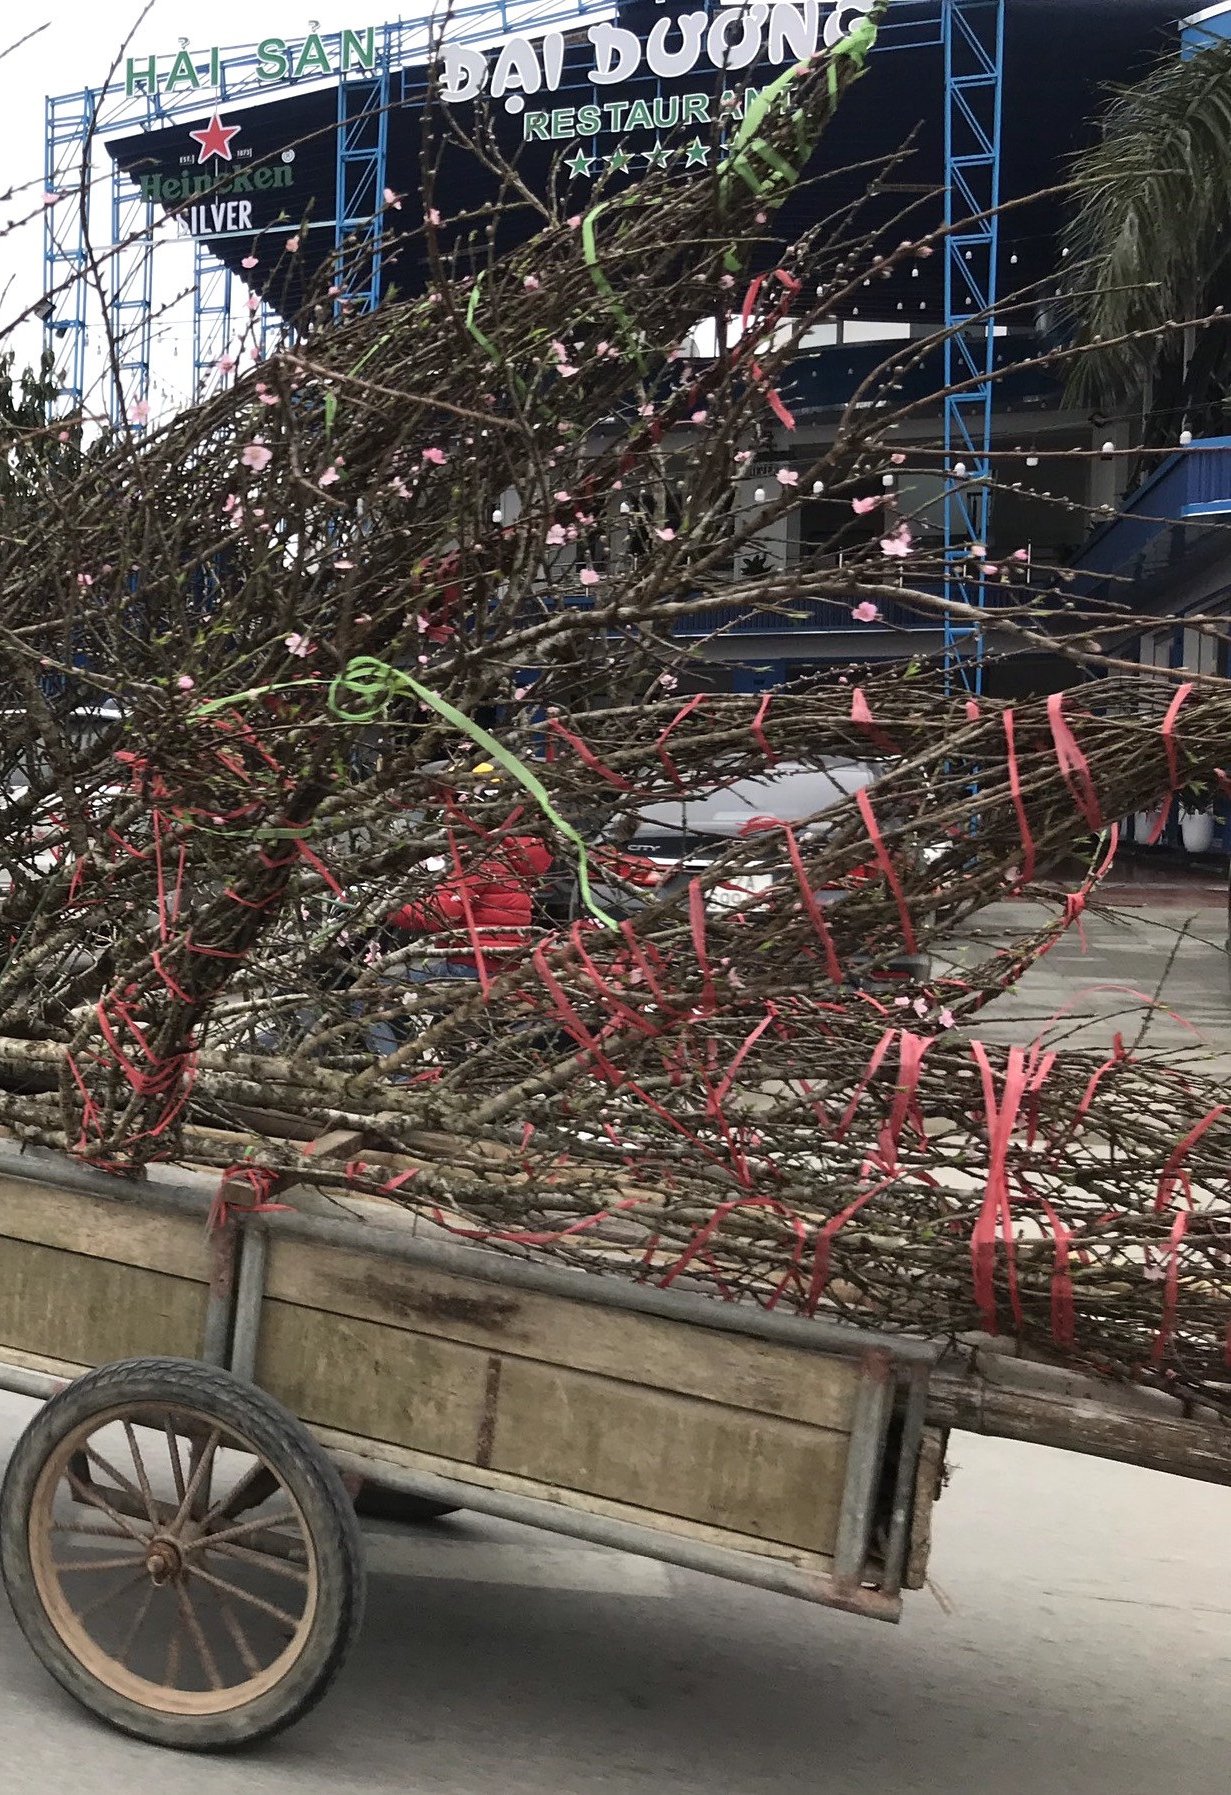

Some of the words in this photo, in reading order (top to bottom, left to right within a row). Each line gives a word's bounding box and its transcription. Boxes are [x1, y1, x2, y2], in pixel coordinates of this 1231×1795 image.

[125, 37, 220, 99] HẢI
[255, 19, 376, 82] SẢN
[438, 32, 565, 115] ĐẠI
[139, 164, 294, 204] Heineken
[176, 200, 252, 235] SILVER
